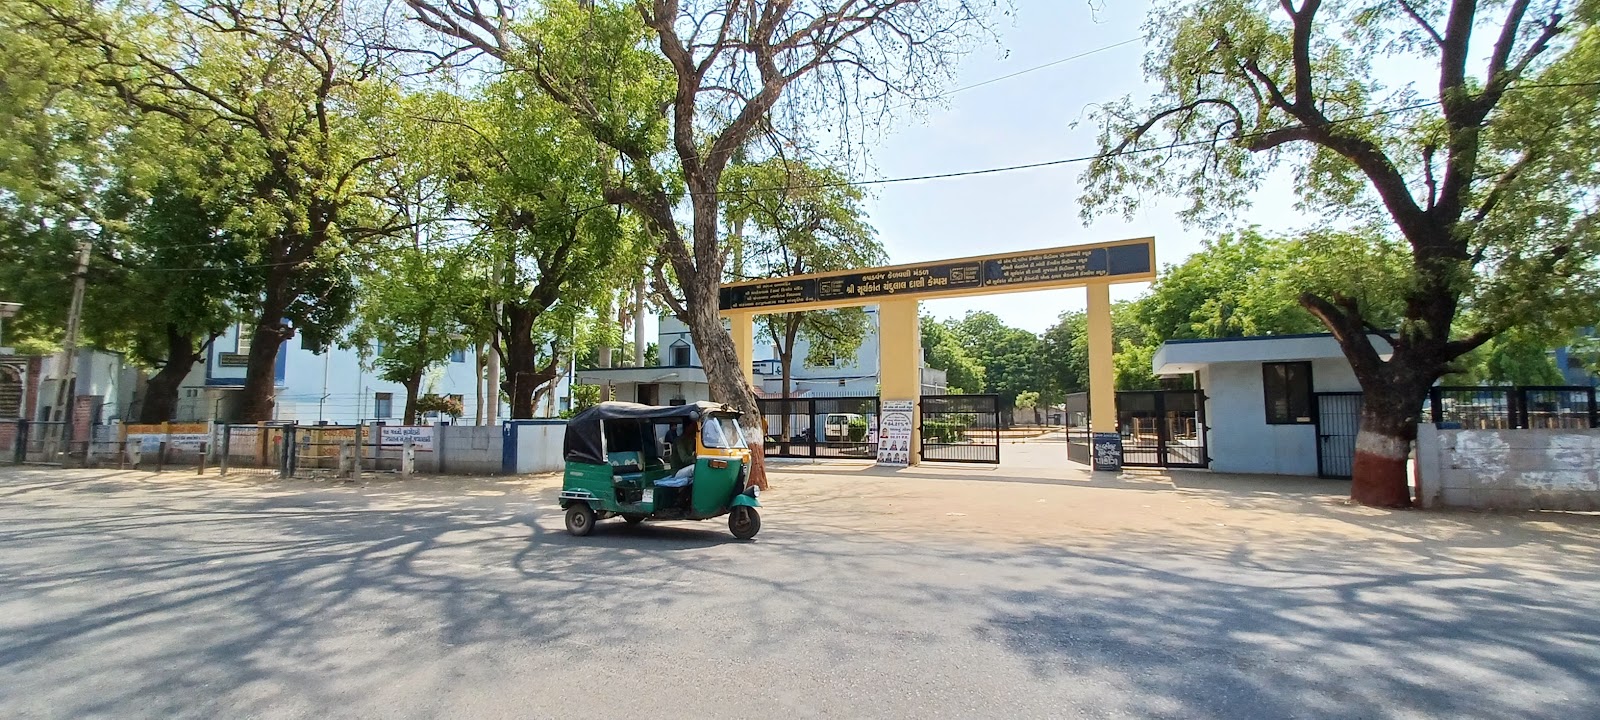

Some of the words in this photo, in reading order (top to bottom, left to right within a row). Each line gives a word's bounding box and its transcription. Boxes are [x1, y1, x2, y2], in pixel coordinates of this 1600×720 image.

[888, 270, 910, 279] કેળવણી
[857, 282, 880, 295] સૂર્યકાંત
[883, 281, 906, 293] ચંદુલાલ
[909, 277, 924, 288] દાણી
[928, 276, 947, 286] કેમ્પસ
